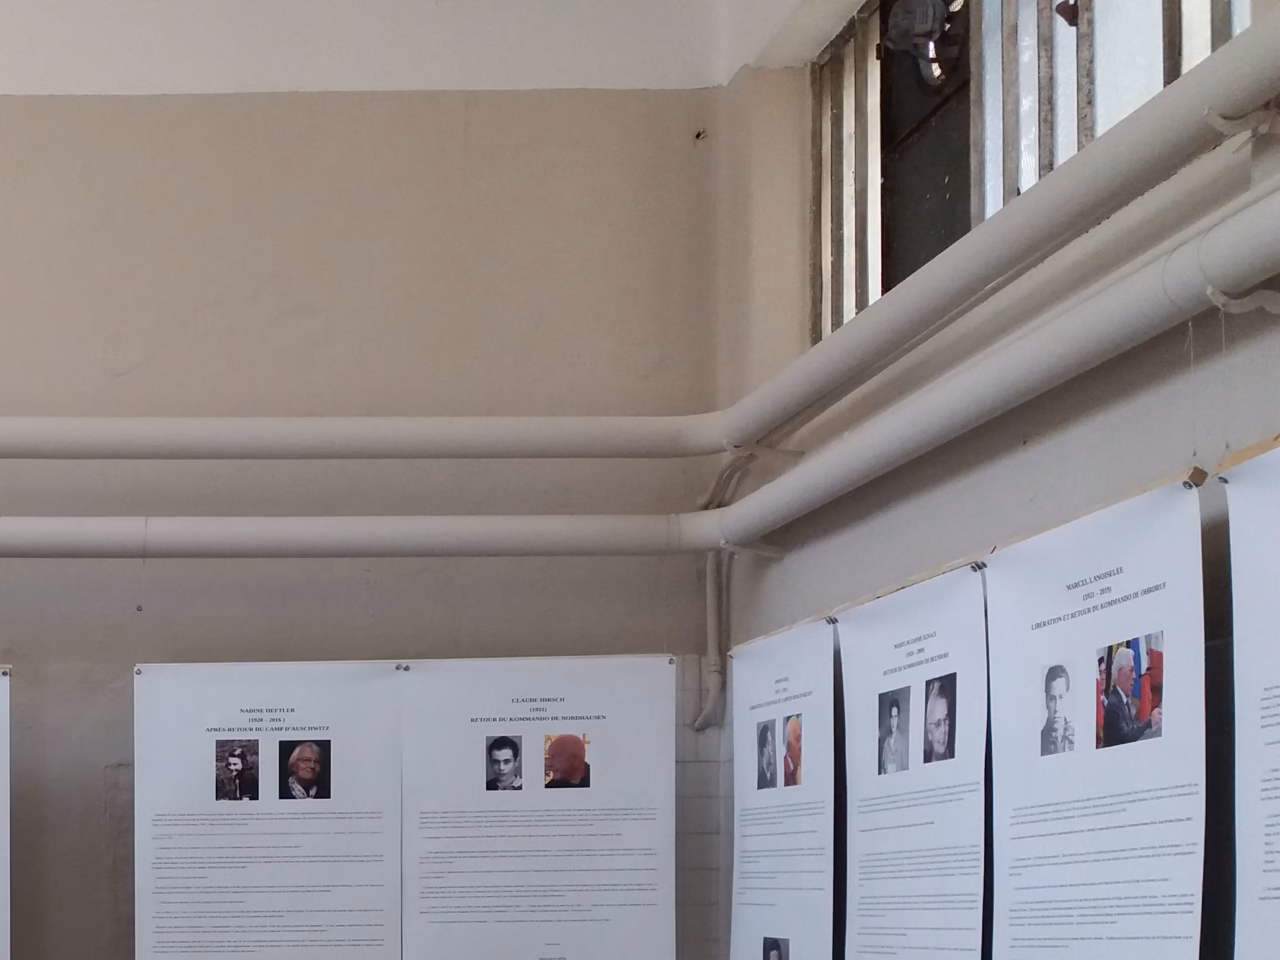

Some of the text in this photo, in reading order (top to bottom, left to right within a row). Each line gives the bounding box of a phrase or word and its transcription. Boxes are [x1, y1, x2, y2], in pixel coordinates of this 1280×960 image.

[1066, 577, 1090, 591] MARCEL
[1031, 614, 1063, 631] LIBÉRATION
[1062, 613, 1070, 622] ET
[1070, 606, 1092, 620] RETOUR
[1092, 603, 1100, 612] DU
[1100, 593, 1132, 610] KOMMANDO
[1132, 590, 1140, 600] DE
